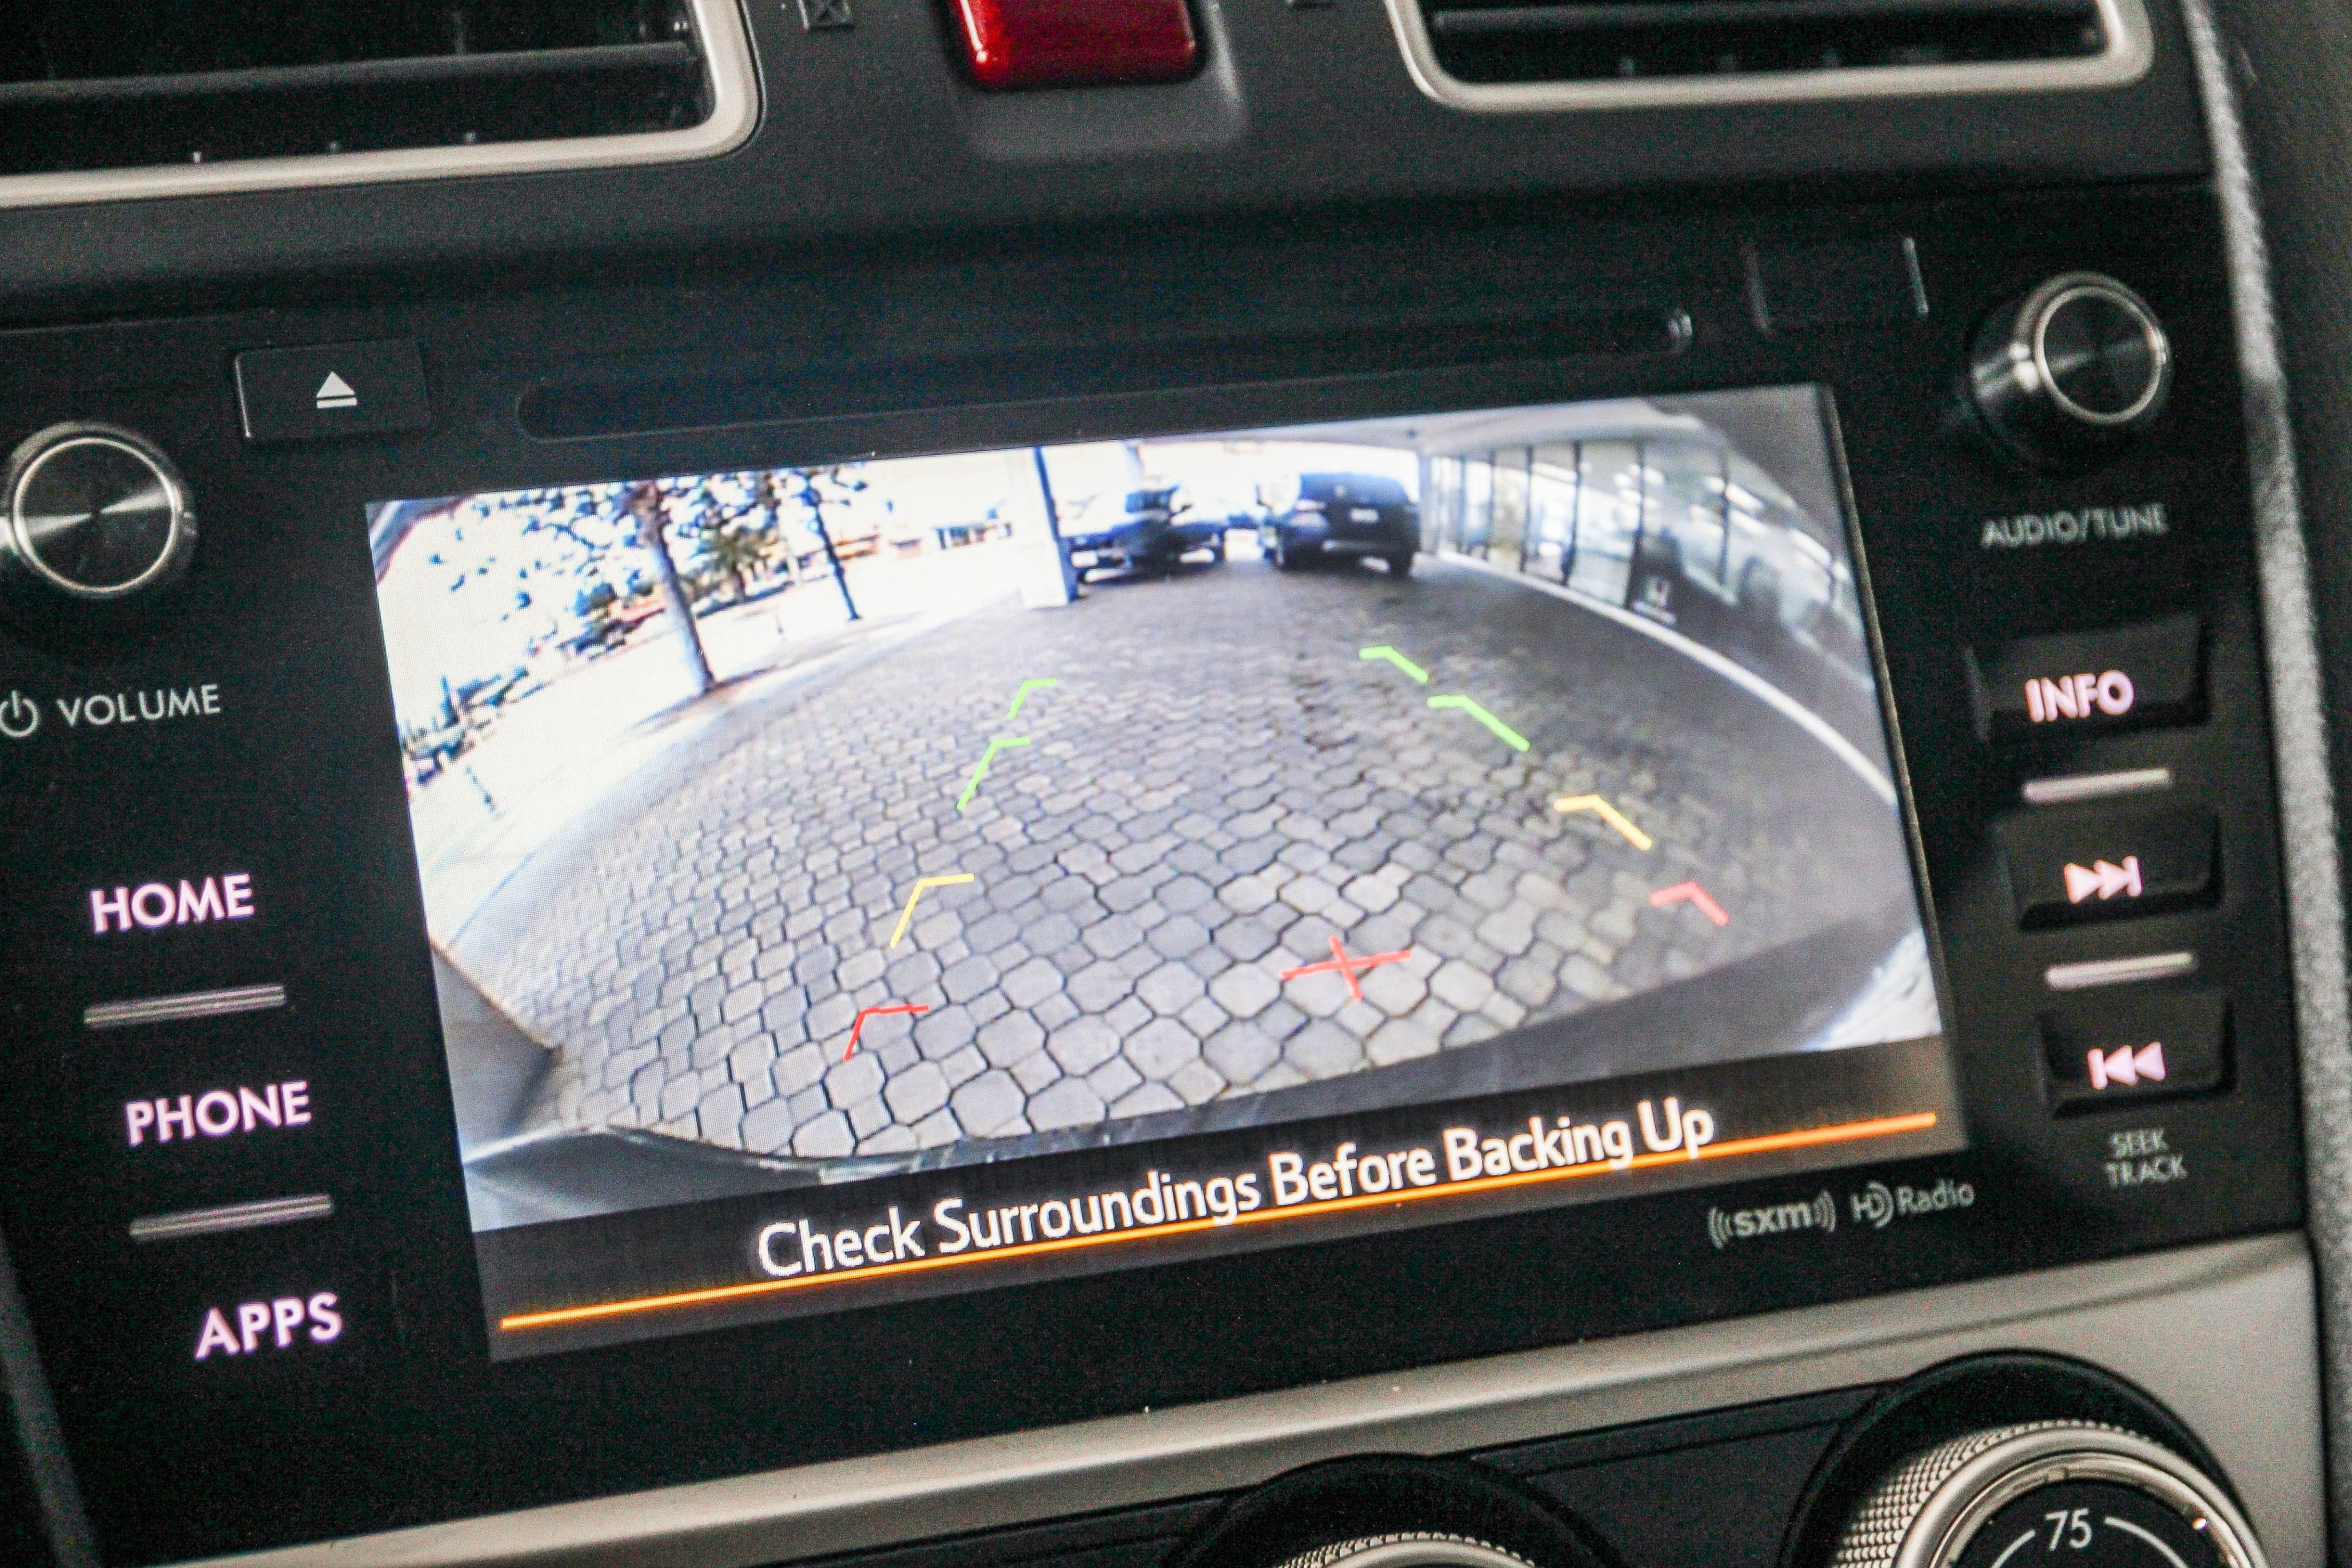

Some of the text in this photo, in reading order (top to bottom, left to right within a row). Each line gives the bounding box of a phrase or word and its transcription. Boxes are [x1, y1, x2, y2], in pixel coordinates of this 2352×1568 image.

[1981, 503, 2169, 549] AUDIO/TUNE
[57, 684, 221, 727] VOLUME
[2025, 670, 2135, 723] INFO
[90, 873, 254, 933] HOME
[125, 1080, 312, 1147] PHONE
[2110, 1130, 2169, 1158] SEEK
[758, 1097, 1715, 1277] Check Surroundings Before Backing Up
[2105, 1154, 2188, 1189] TRACK
[1897, 1178, 1975, 1215] Radio
[195, 1292, 342, 1361] APPS
[2044, 1508, 2093, 1551] 75
